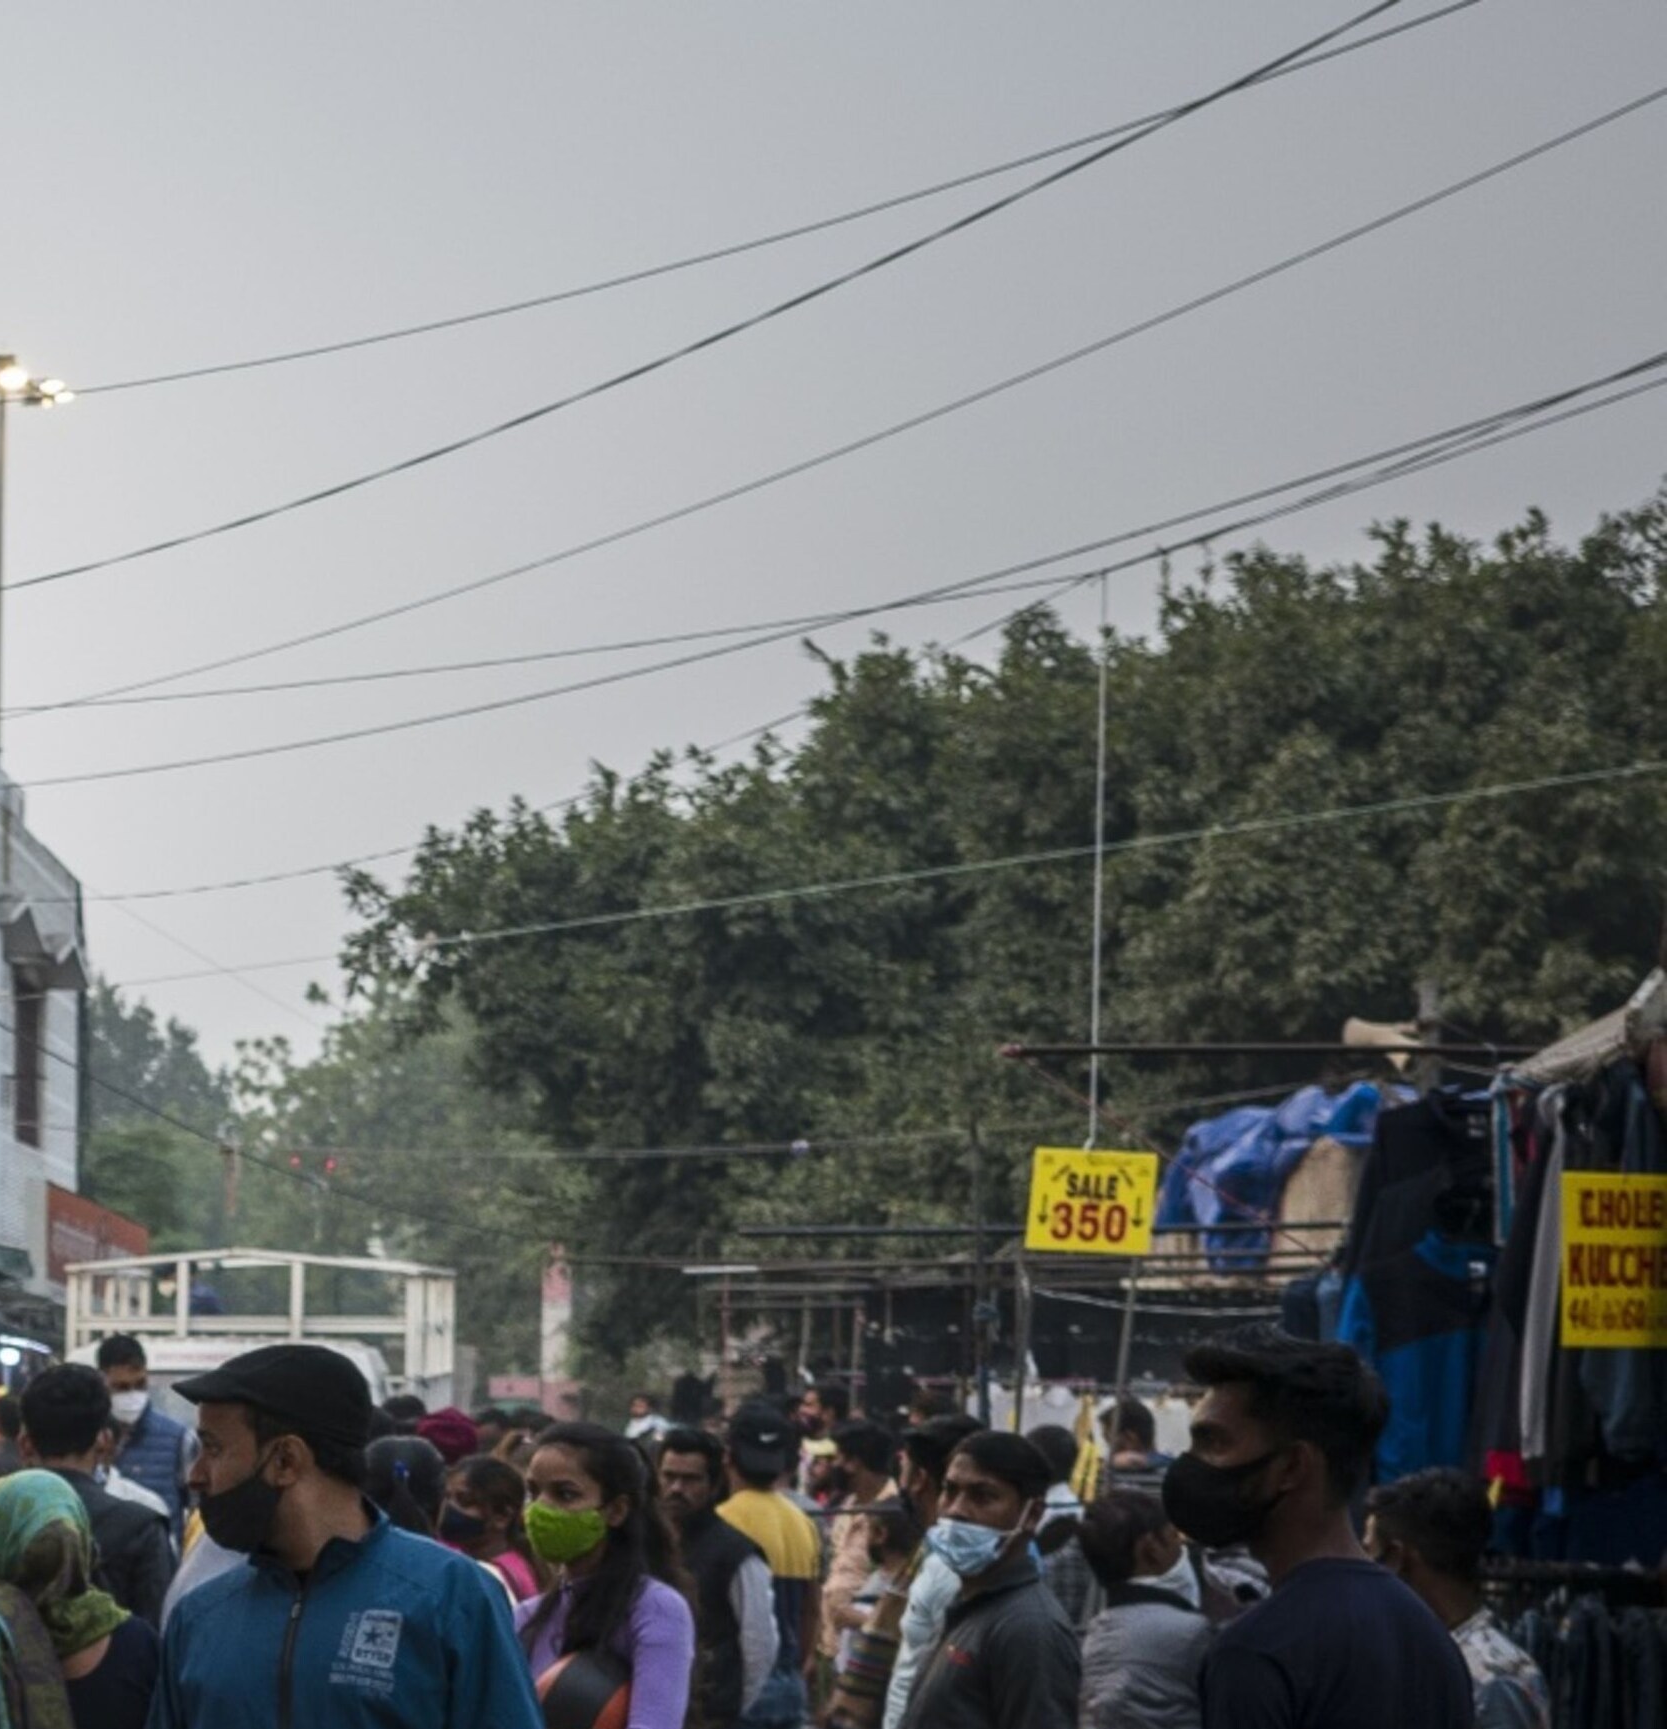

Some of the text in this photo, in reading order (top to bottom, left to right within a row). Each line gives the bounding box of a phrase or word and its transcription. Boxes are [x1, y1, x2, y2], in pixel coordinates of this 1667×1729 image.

[1065, 1171, 1119, 1201] SALE
[1050, 1200, 1128, 1244] 350
[1580, 1188, 1664, 1230] CHOLE
